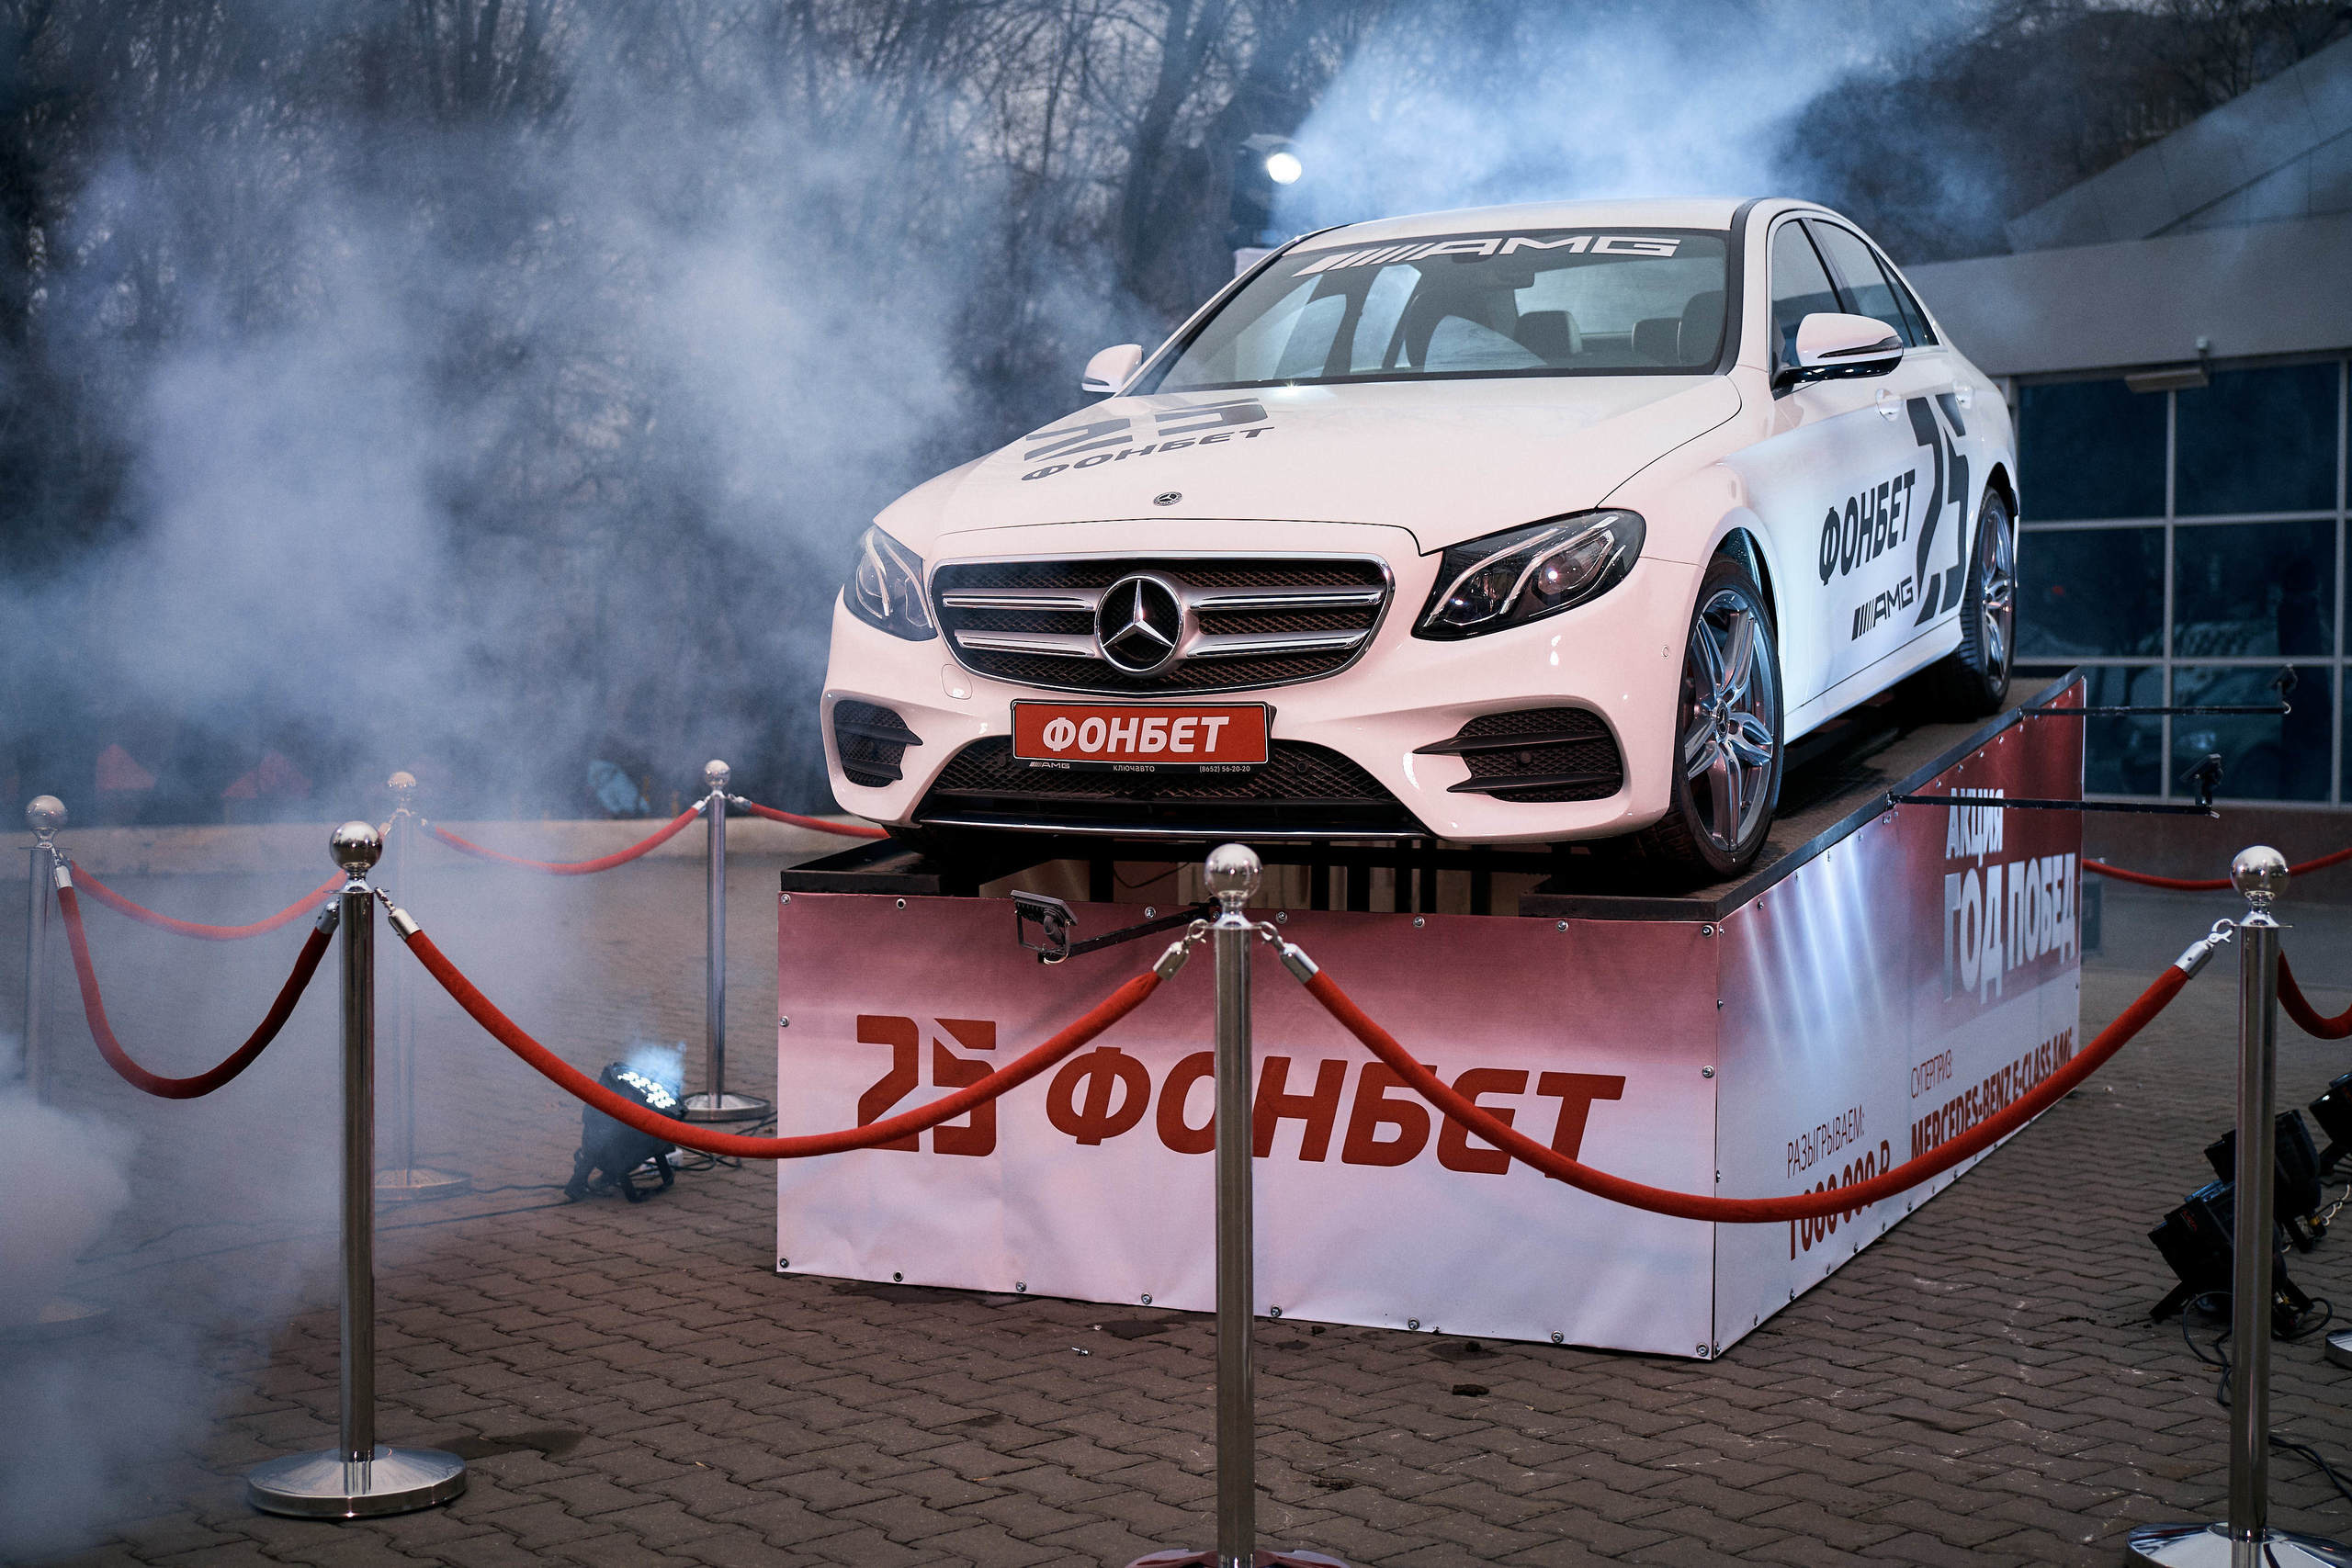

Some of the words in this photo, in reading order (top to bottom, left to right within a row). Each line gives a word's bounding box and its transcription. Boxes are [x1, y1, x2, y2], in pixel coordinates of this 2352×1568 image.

[1021, 426, 1275, 481] ФОНБЕТ
[1023, 398, 1268, 463] 25
[1818, 468, 1916, 586] ФОНБЕТ
[1905, 392, 1970, 627] 25
[1042, 716, 1230, 753] ФОНБЕТ
[1199, 764, 1220, 773] (8652)
[1221, 764, 1250, 773] 56-20-20
[1945, 787, 2004, 868] АКЦИЯ
[1943, 864, 2003, 1005] ГОД
[2007, 852, 2076, 972] ПОБЕД
[856, 1014, 997, 1156] 25
[1046, 1045, 1626, 1179] ФОНБЕТ
[1910, 1064, 2011, 1161] MERCEDES-BENZ
[1787, 1104, 1865, 1179] РАЗЫГРЫВАЕМ:
